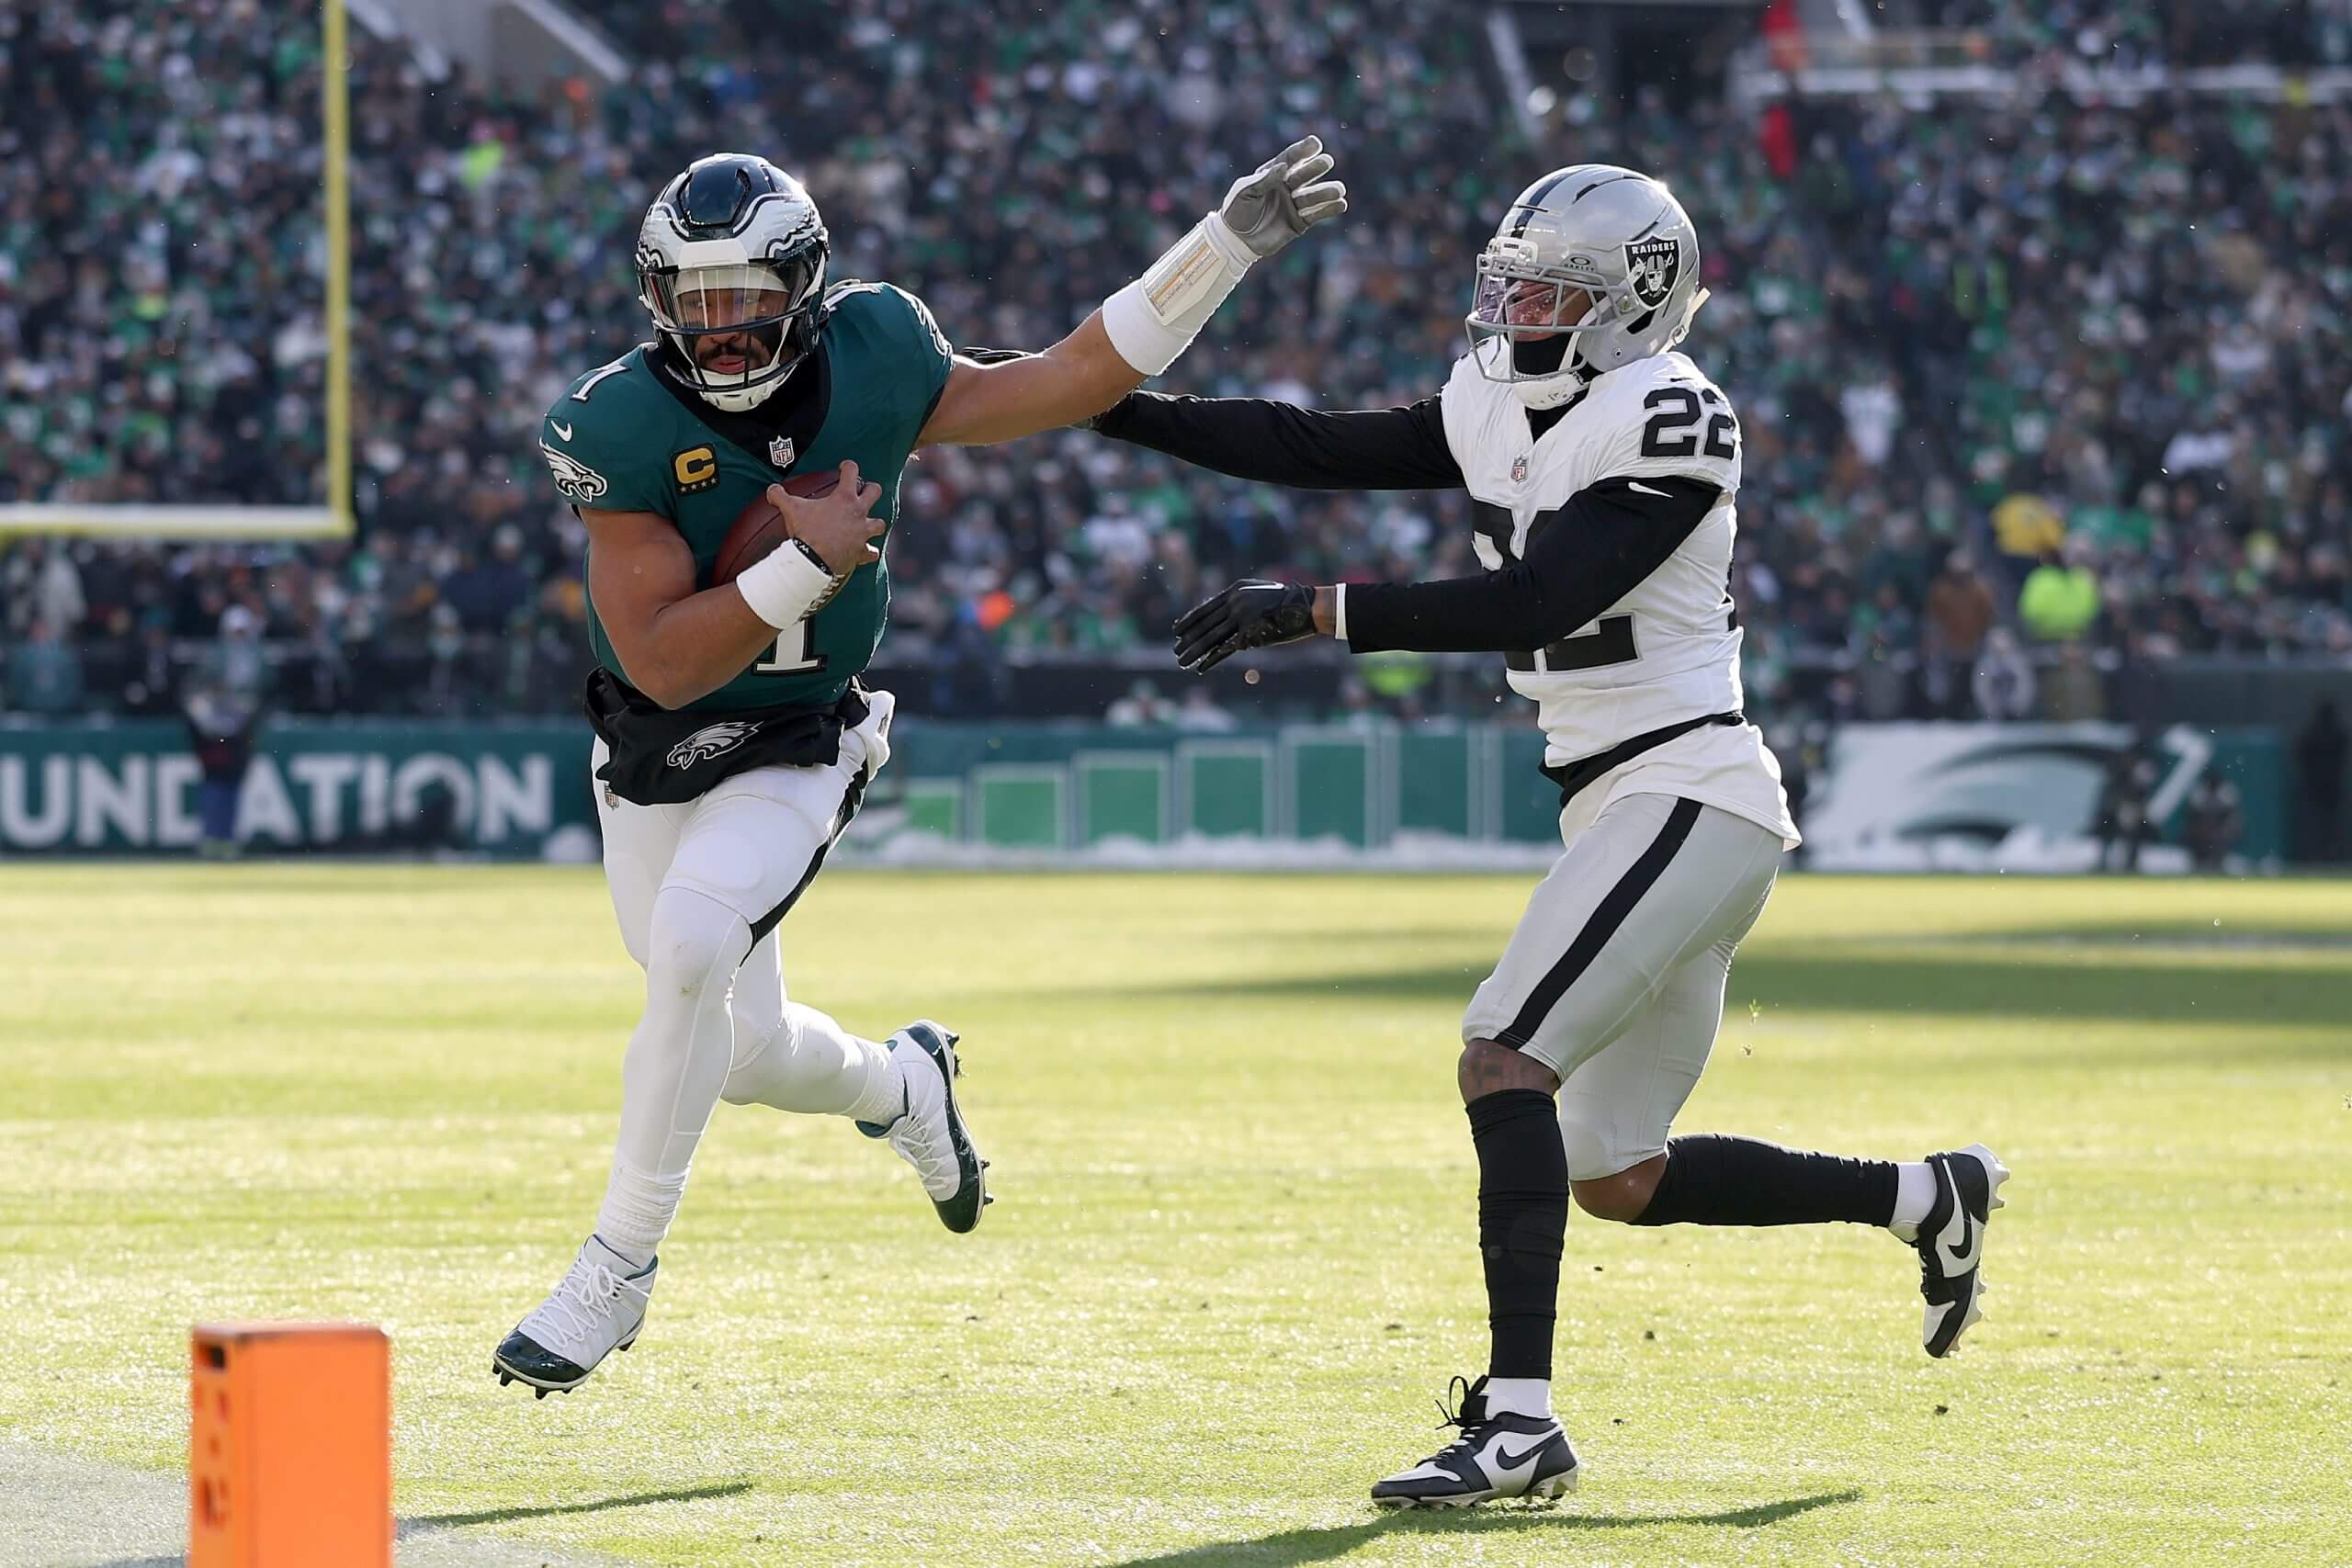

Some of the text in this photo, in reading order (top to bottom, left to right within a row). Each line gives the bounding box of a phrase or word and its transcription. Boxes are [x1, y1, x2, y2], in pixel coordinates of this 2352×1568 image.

[1631, 242, 1675, 254] RAIDERS
[571, 364, 631, 402] 1
[1640, 387, 1736, 461] 22
[675, 447, 715, 484] C
